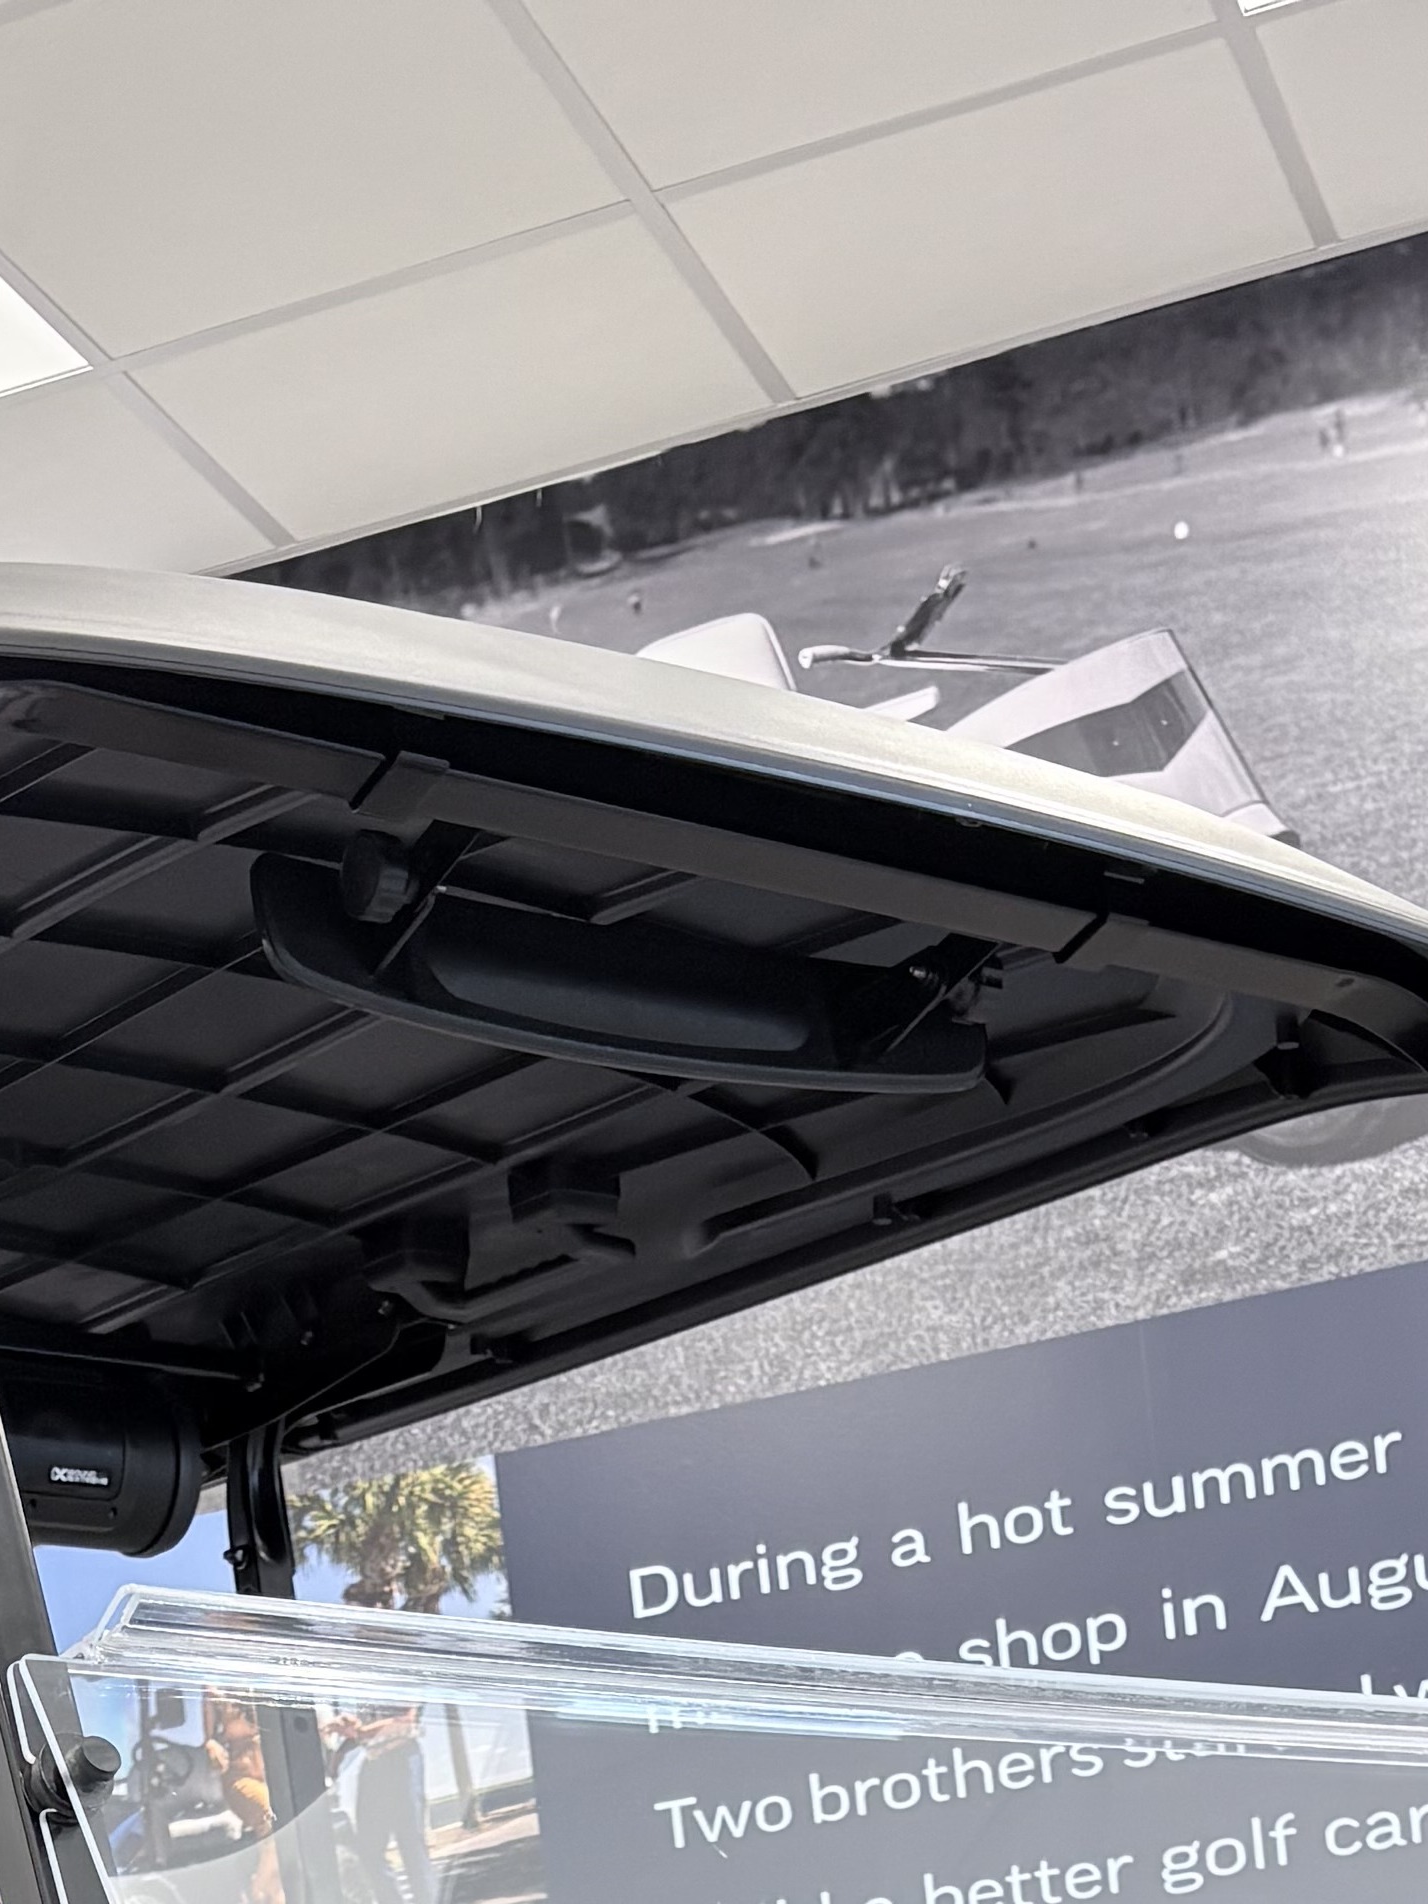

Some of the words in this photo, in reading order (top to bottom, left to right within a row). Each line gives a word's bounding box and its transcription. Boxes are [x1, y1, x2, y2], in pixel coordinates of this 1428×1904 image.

[630, 1536, 862, 1618] During
[892, 1529, 931, 1567] a
[958, 1490, 1073, 1554] hot
[1105, 1432, 1402, 1524] summer
[957, 1610, 1126, 1664] shop
[1162, 1588, 1226, 1639] in
[654, 1796, 792, 1848] Two
[808, 1738, 1105, 1825] brothers
[1162, 1813, 1296, 1894] golf
